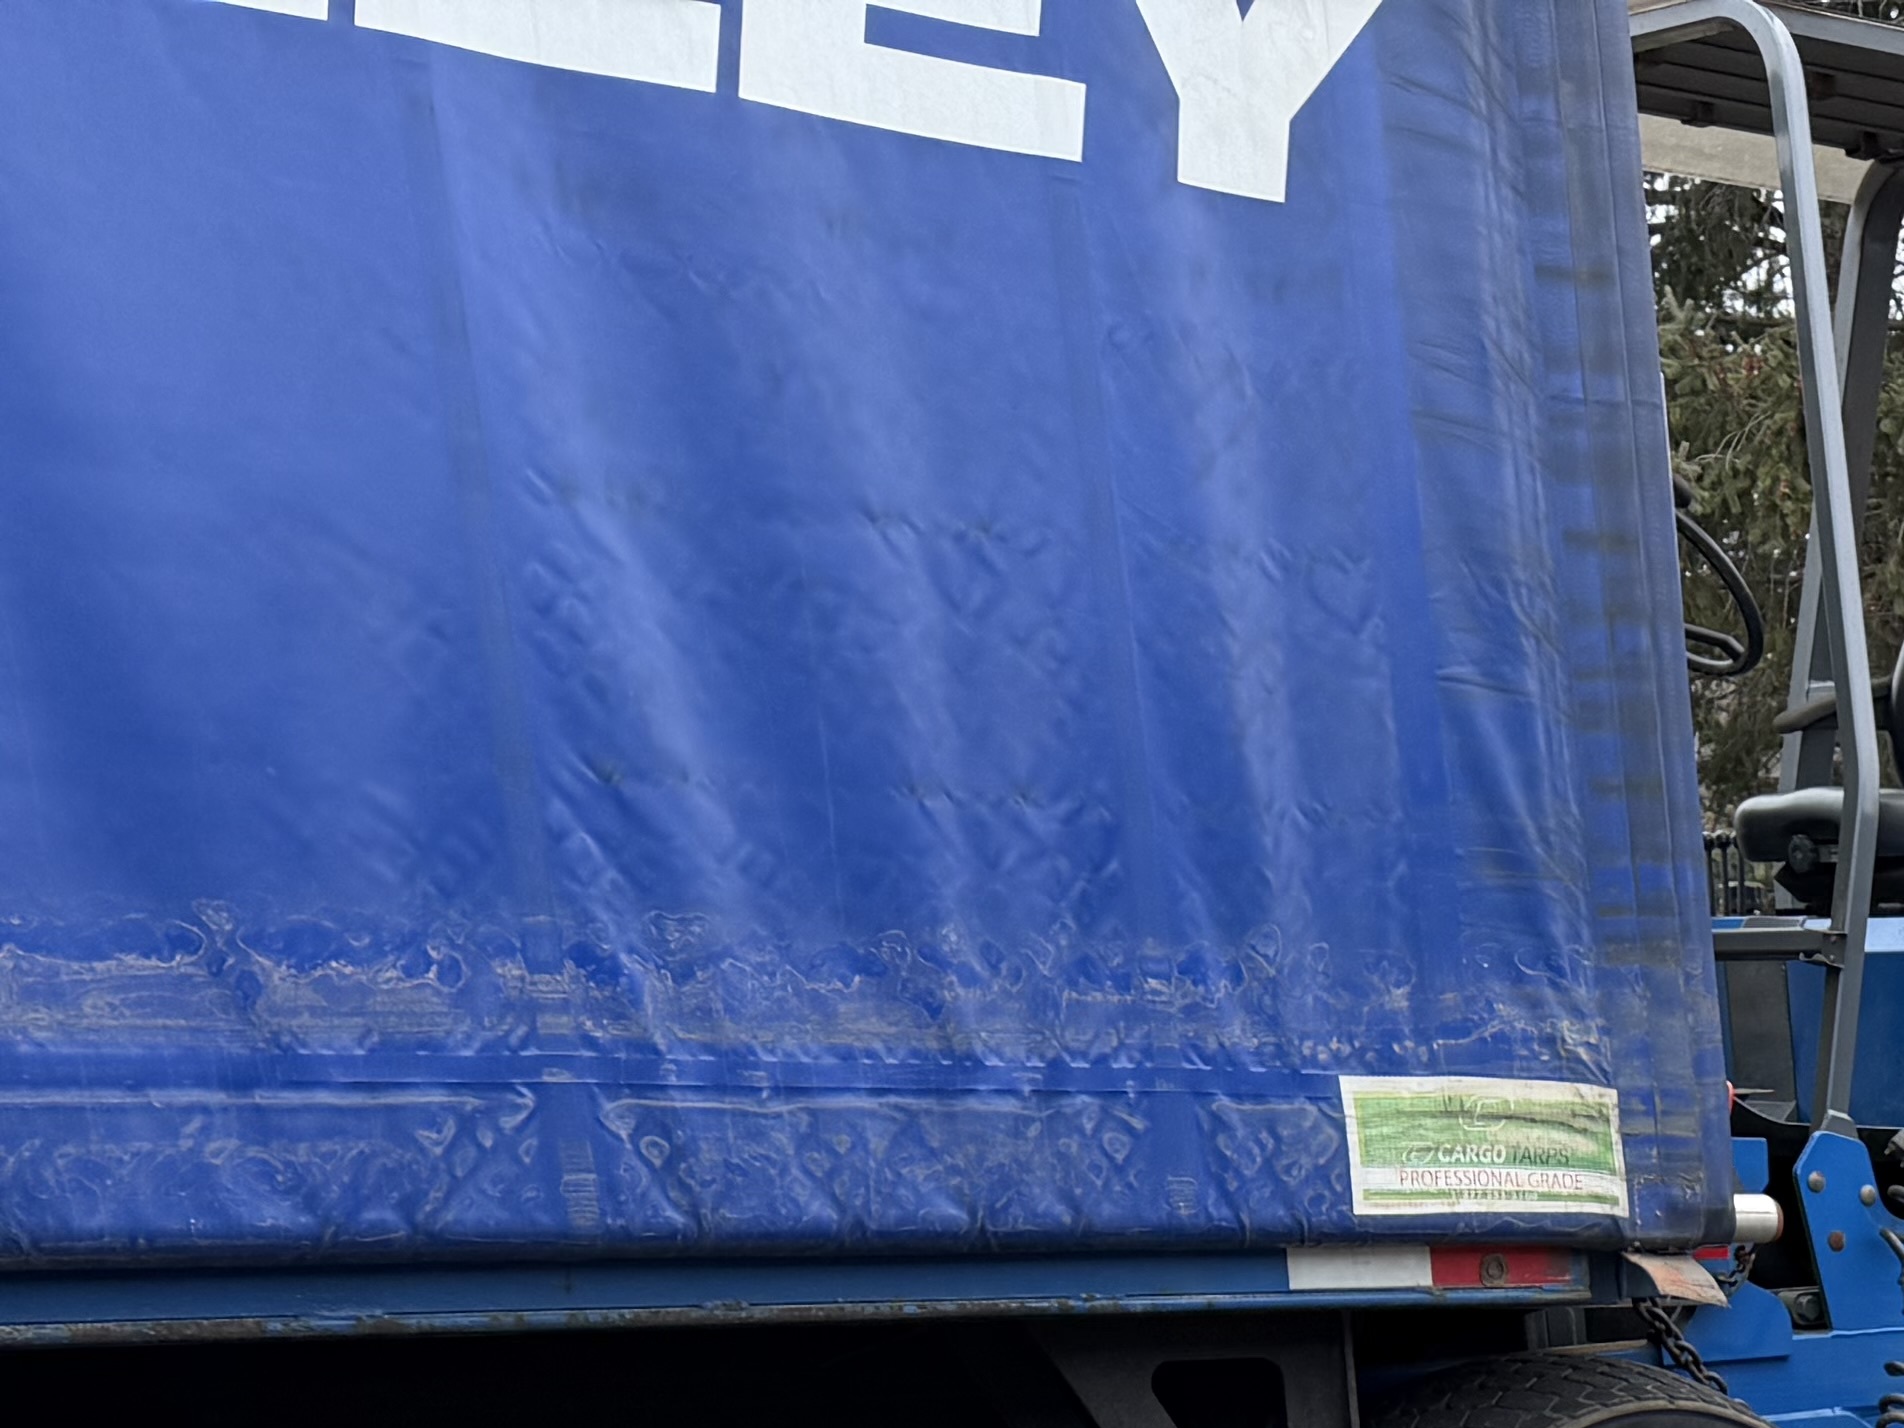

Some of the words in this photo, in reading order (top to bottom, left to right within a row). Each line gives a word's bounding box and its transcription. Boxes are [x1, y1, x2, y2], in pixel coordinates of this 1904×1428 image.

[1437, 1144, 1506, 1164] CARGO
[1511, 1145, 1570, 1166] TARPS
[1399, 1169, 1523, 1189] PROFESSIONAL
[1527, 1172, 1584, 1190] GRADE
